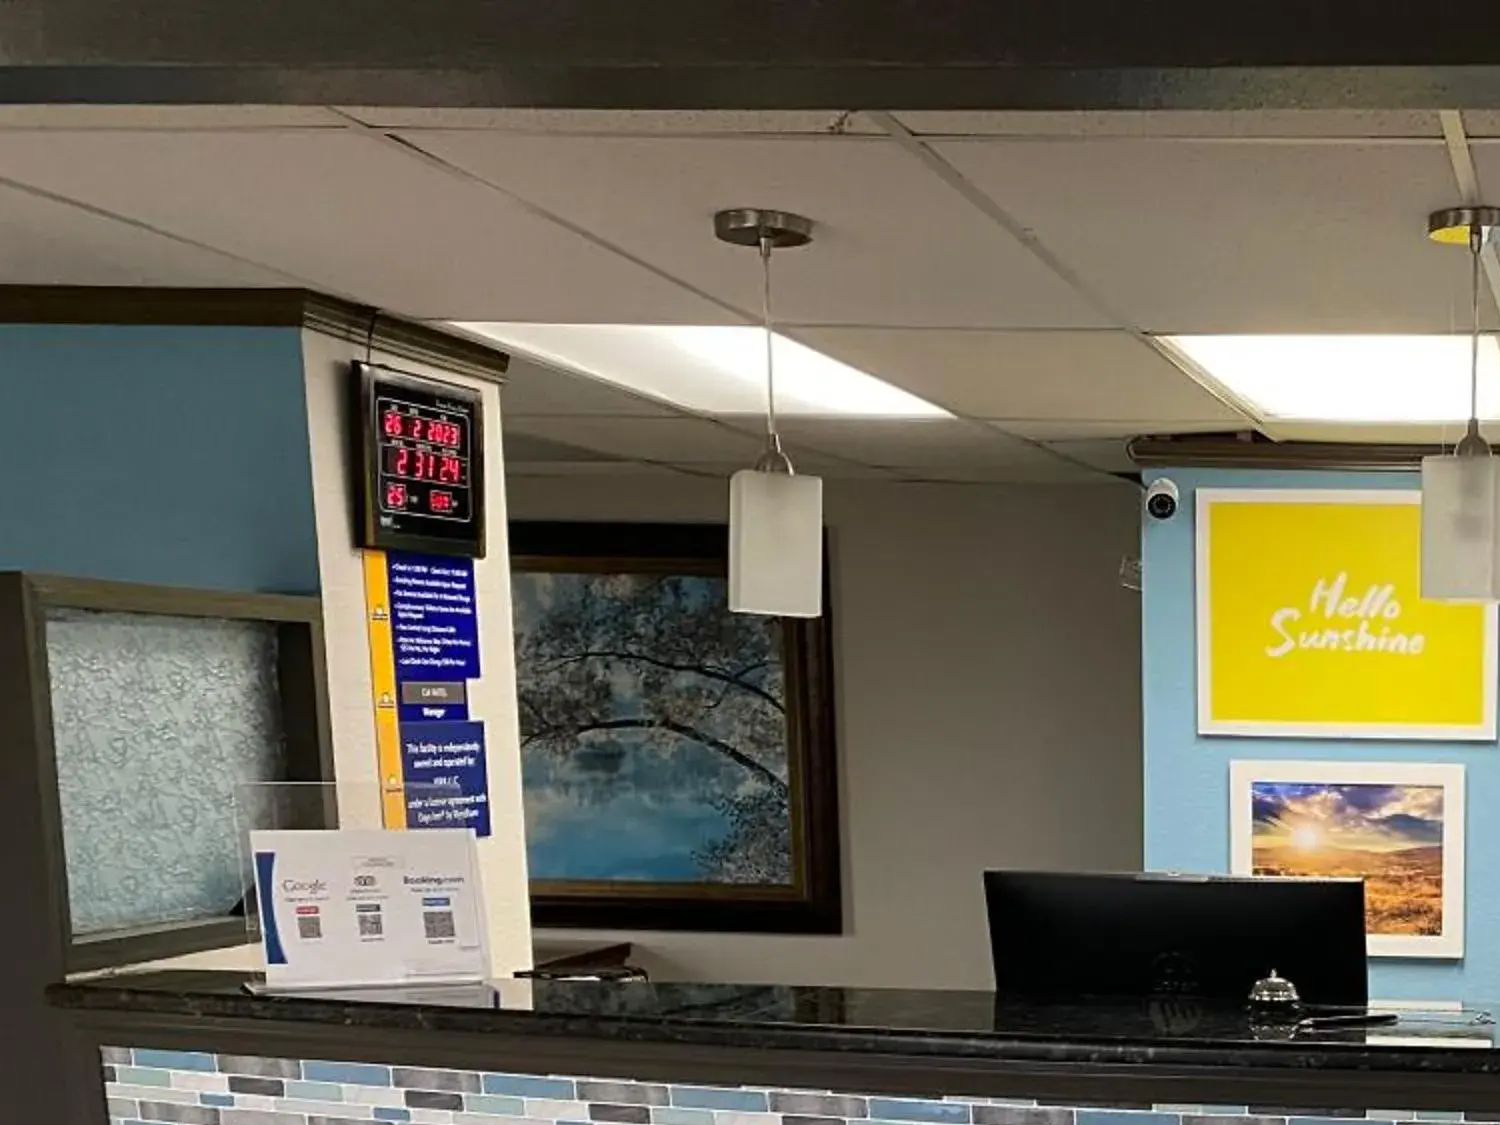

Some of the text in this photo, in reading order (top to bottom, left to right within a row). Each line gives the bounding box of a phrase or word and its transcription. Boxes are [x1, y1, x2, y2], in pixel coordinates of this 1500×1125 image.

[428, 421, 458, 446] 2023
[397, 448, 408, 475] 2
[440, 456, 460, 481] 24
[1309, 571, 1402, 620] Hello
[1265, 607, 1426, 658] Sunshine
[282, 879, 328, 895] Google
